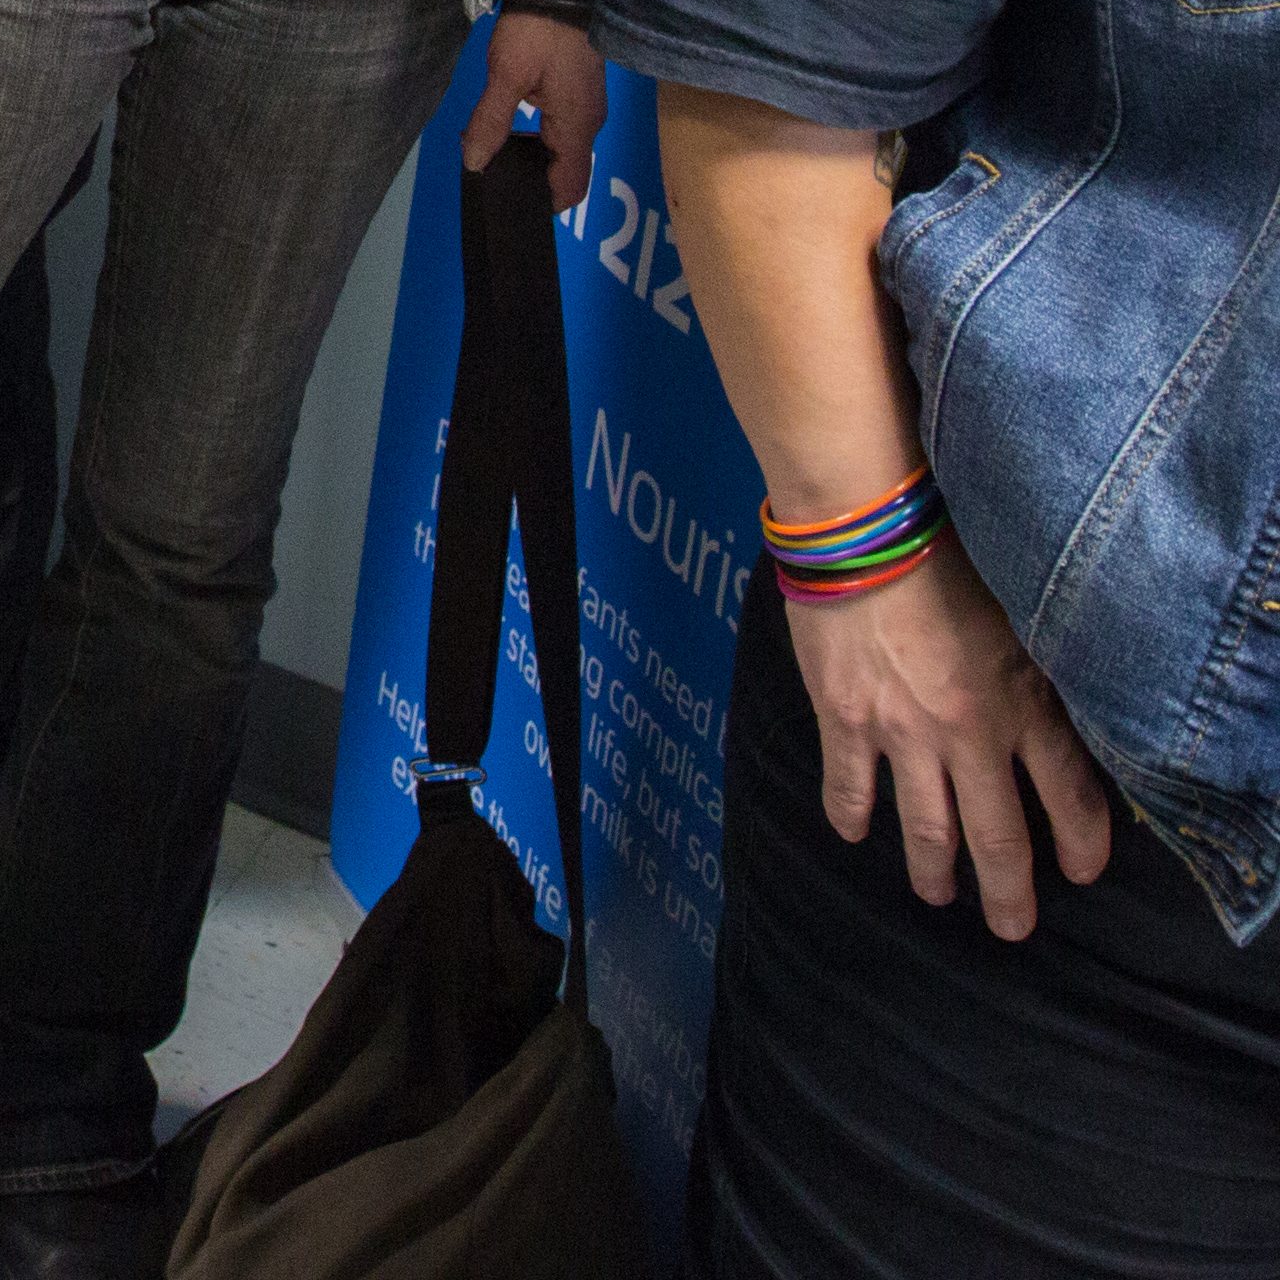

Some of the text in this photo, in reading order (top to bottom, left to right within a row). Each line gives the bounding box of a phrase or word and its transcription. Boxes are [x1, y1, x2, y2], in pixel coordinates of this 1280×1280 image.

[644, 646, 714, 736] need
[587, 712, 632, 801] life,
[638, 769, 682, 850] but
[523, 846, 563, 921] life
[581, 785, 633, 867] milk
[640, 842, 659, 896] is
